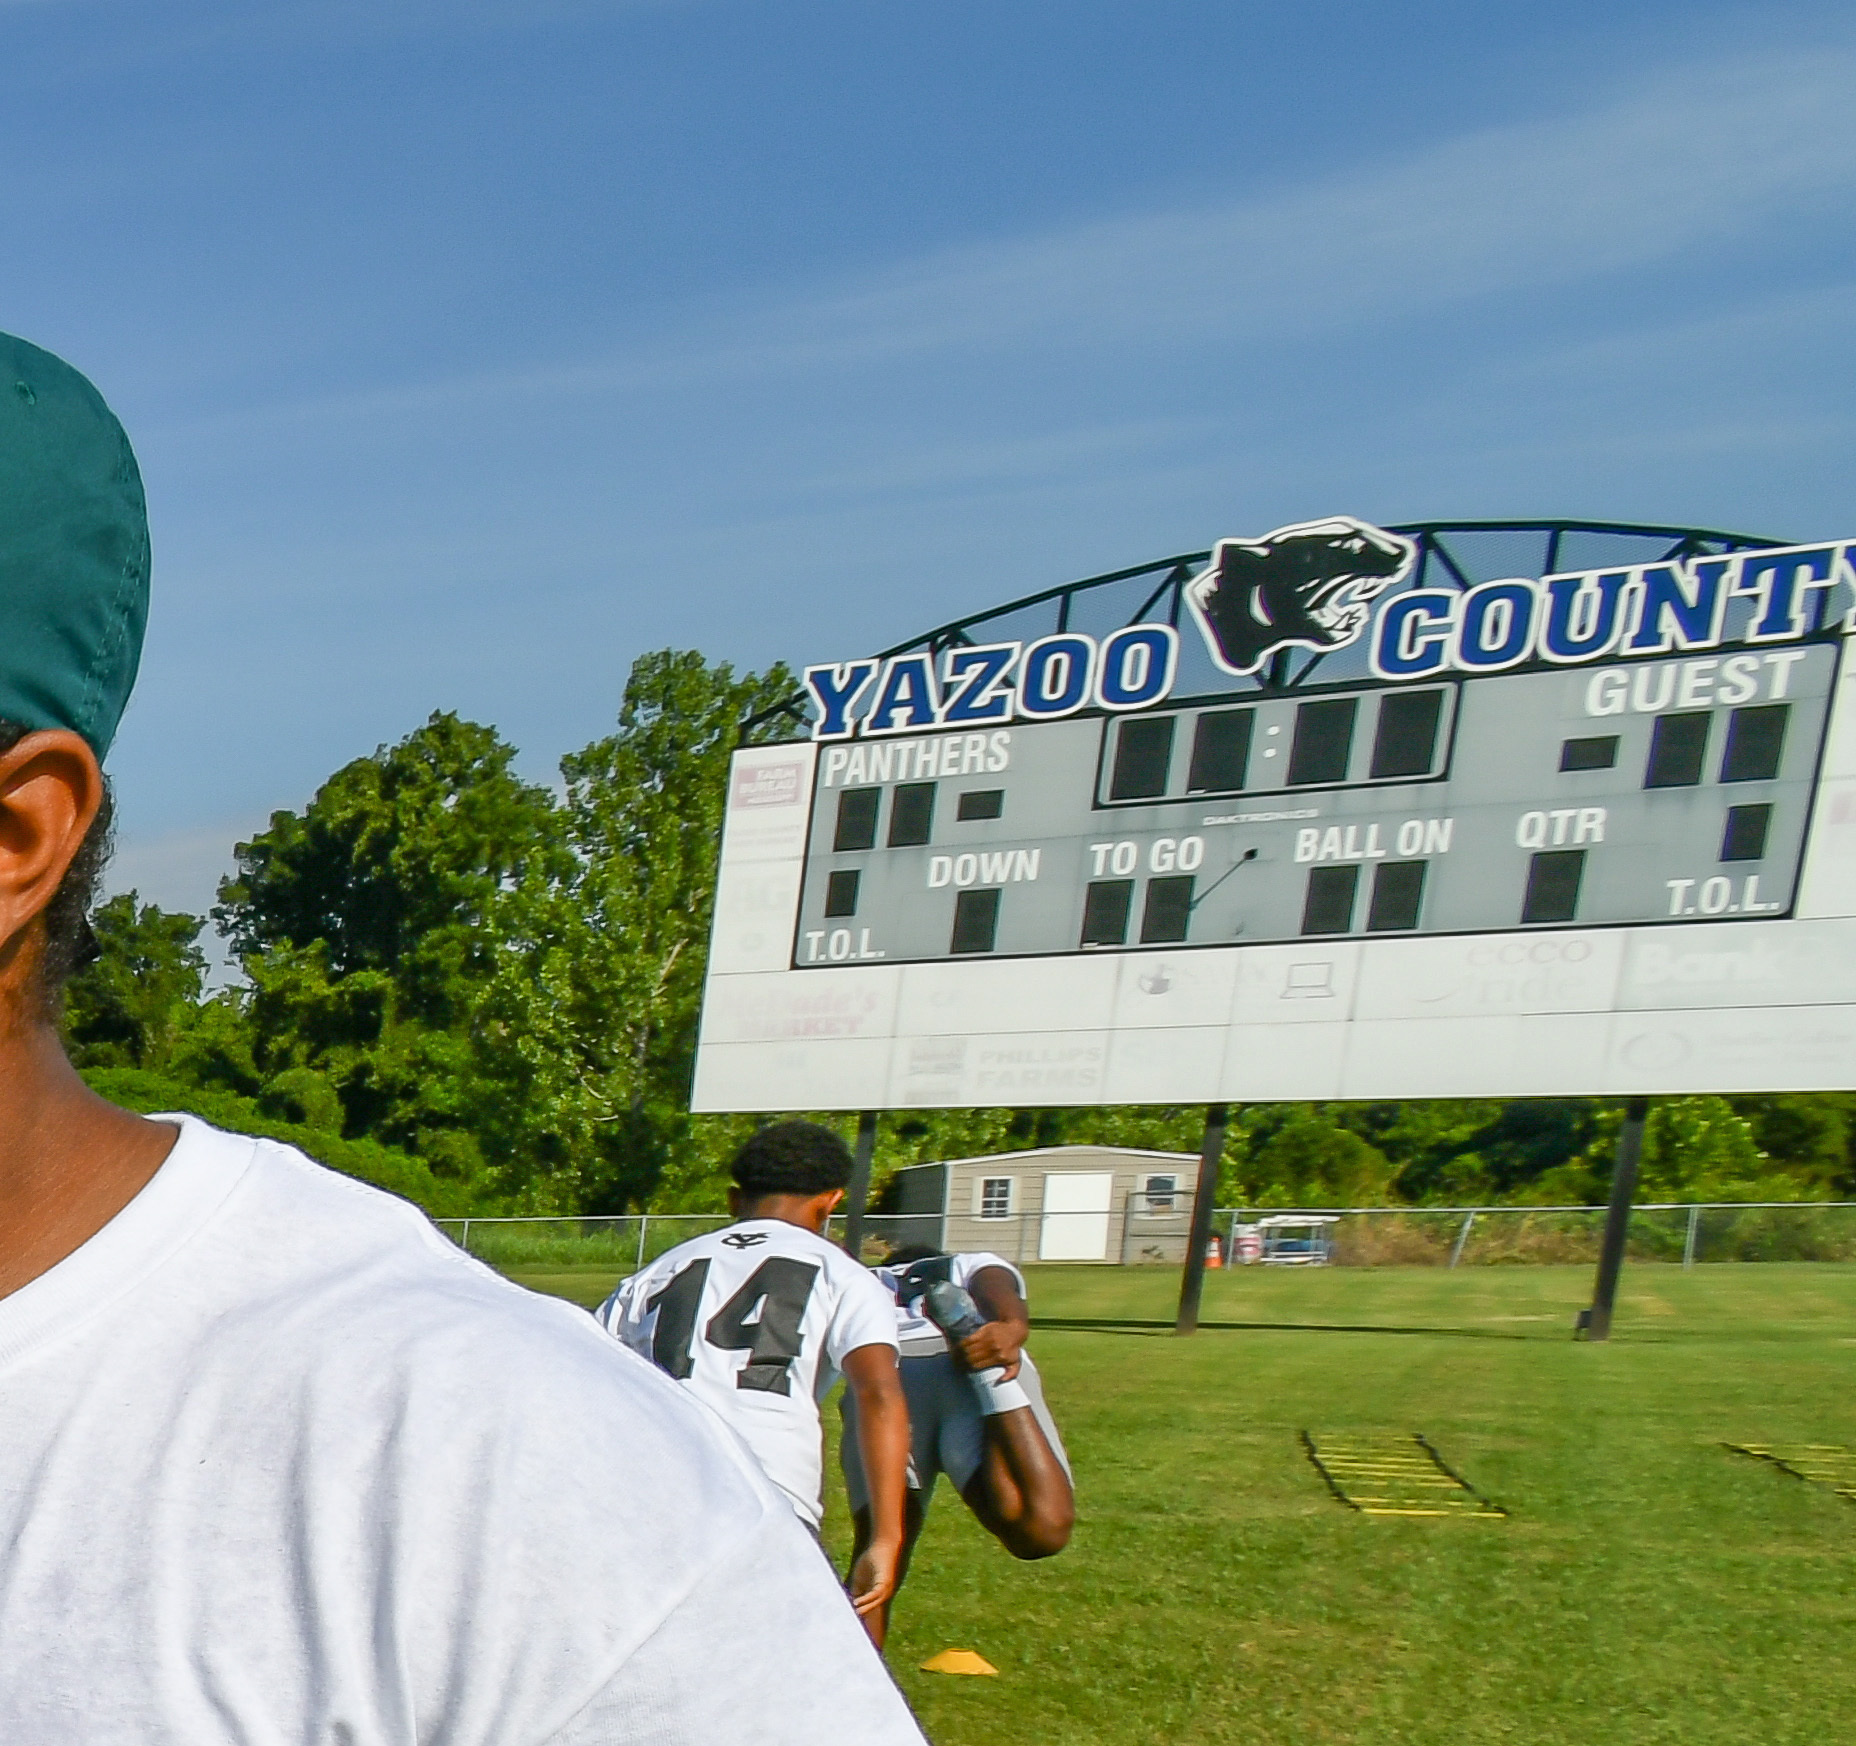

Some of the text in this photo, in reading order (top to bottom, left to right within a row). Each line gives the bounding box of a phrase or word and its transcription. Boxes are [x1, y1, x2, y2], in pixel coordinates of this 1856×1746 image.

[804, 538, 1856, 741] YAZOO COUNT
[1588, 651, 1806, 717] GUEST
[824, 731, 1012, 788] PANTHERS
[1202, 809, 1319, 826] DAKTRONICS
[1515, 807, 1607, 849] QTR
[1091, 836, 1204, 876] TO GO
[1294, 818, 1454, 863] BALL ON
[928, 849, 1041, 888] DOWN
[1666, 875, 1781, 916] T.O.L.
[806, 928, 885, 962] T.O.L.
[646, 1256, 820, 1397] 14
